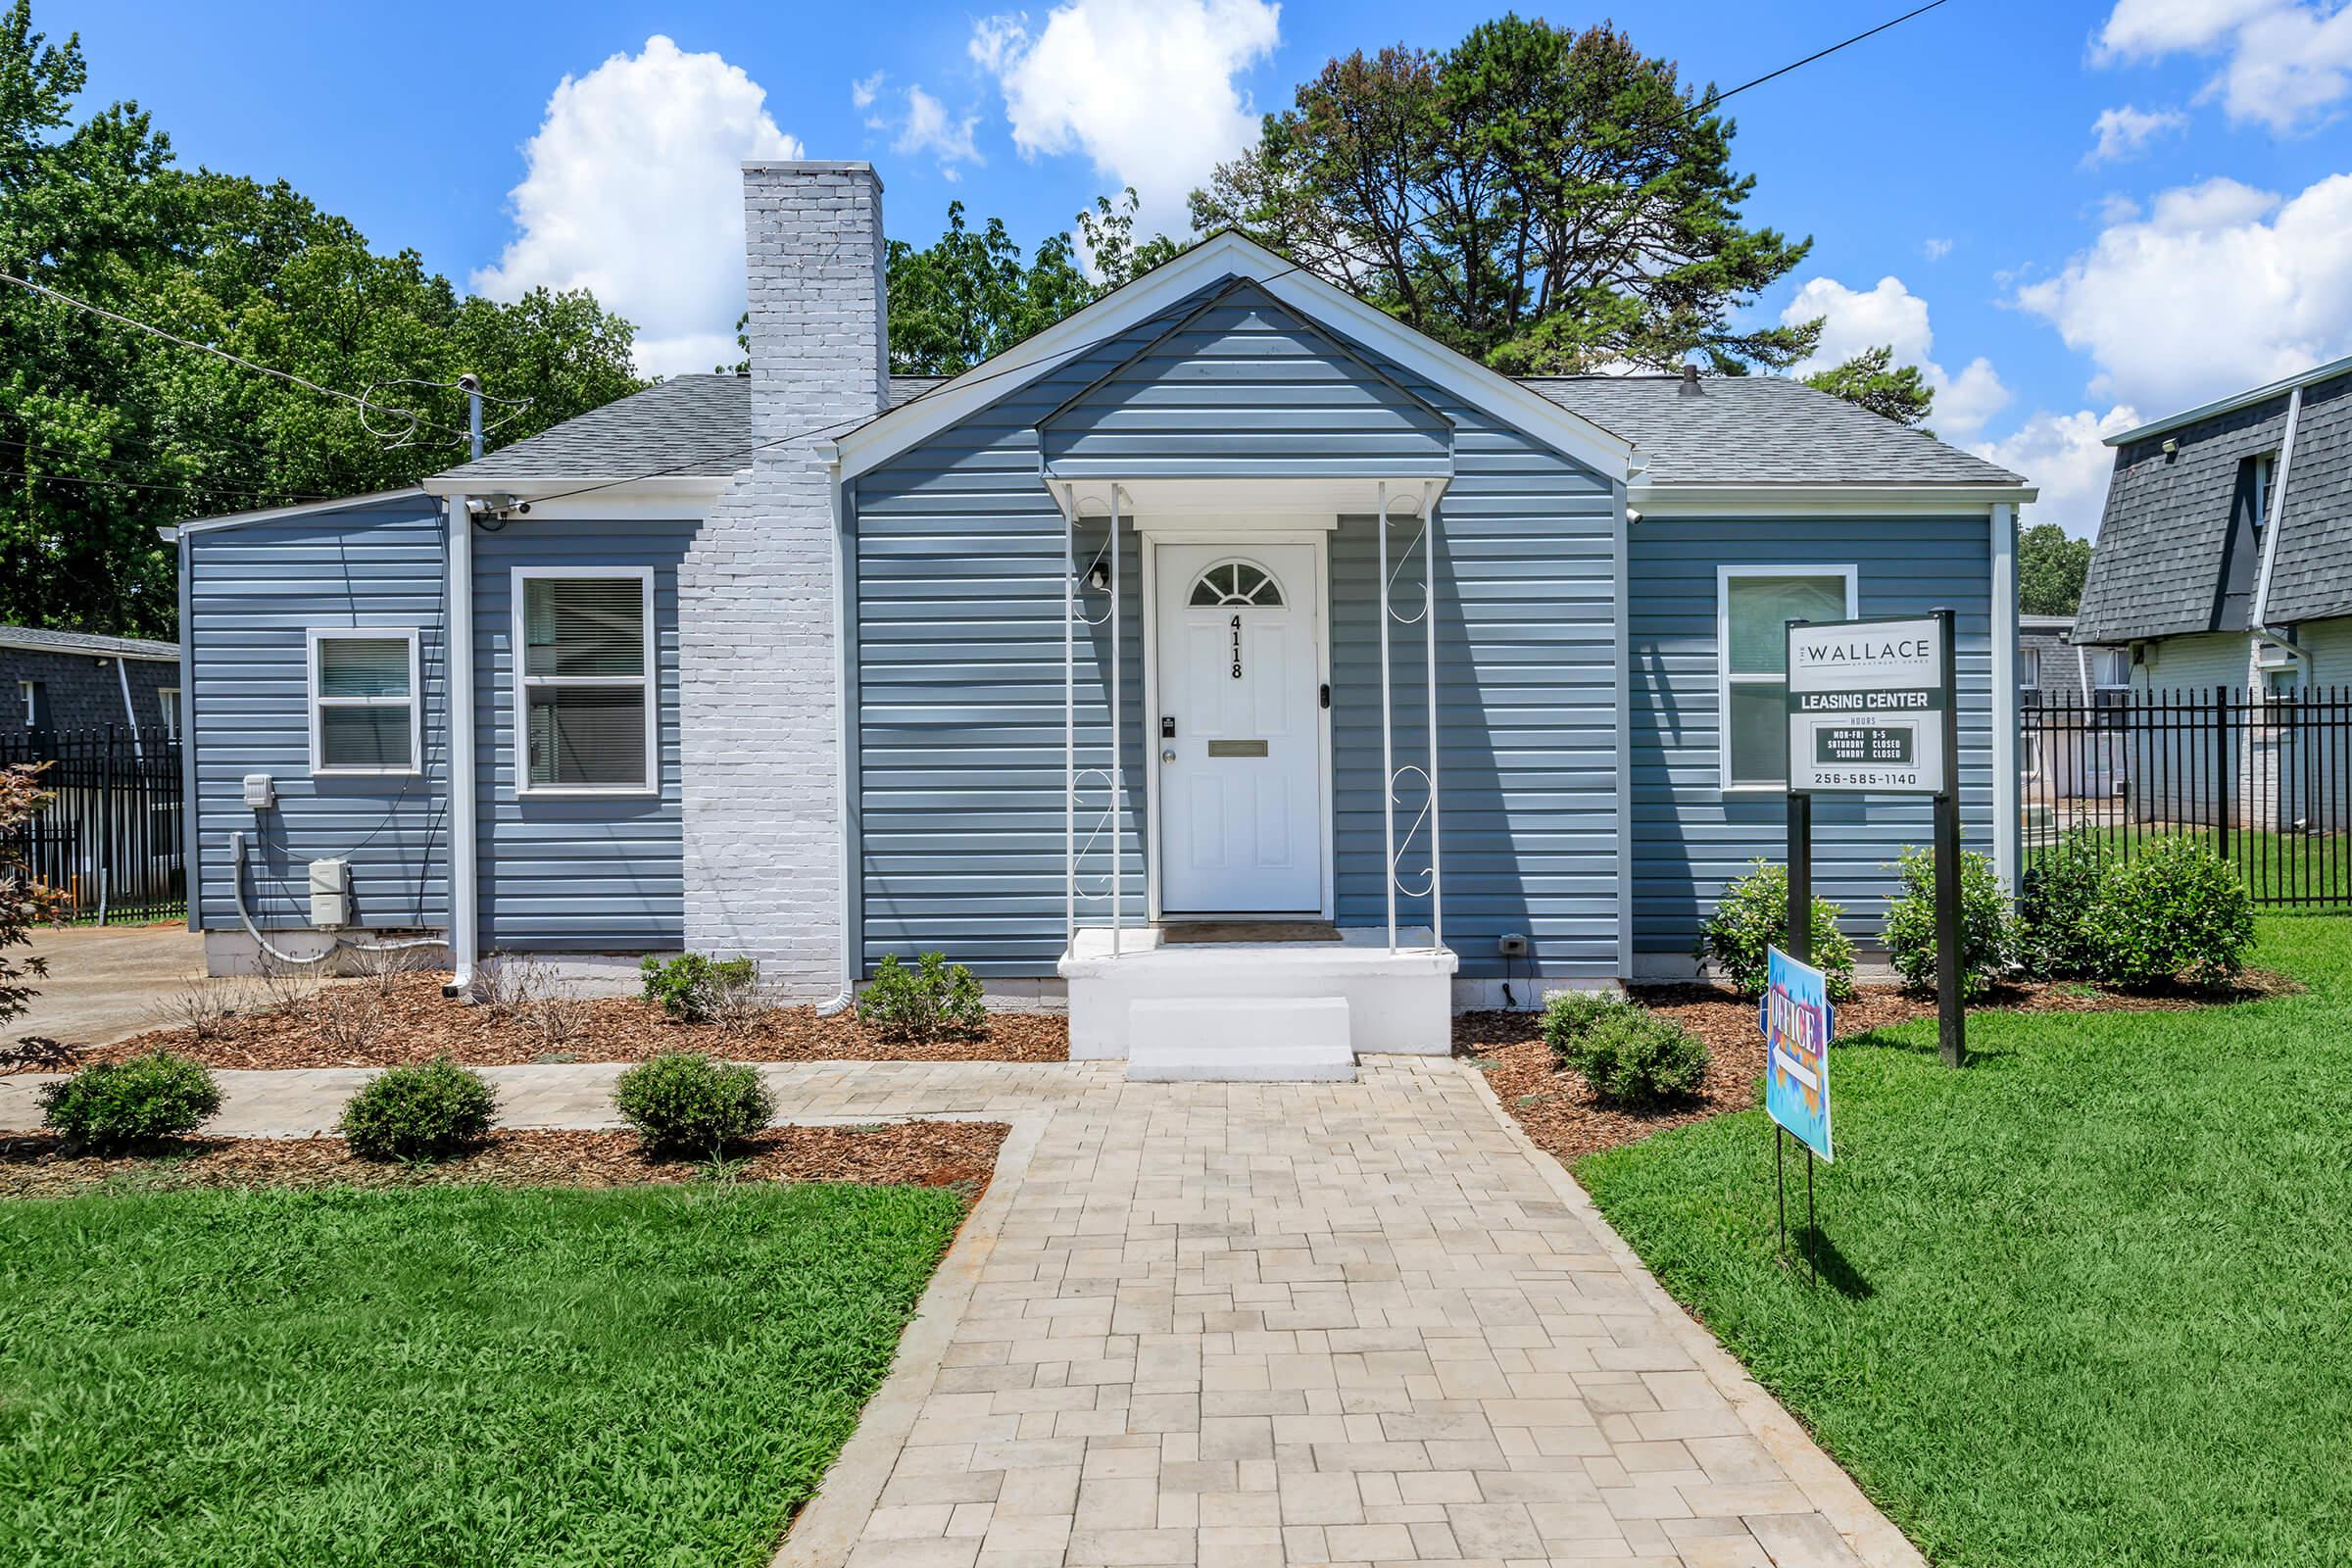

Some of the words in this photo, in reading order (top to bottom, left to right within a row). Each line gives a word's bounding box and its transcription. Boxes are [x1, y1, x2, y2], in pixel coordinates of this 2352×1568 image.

[1231, 615, 1242, 678] 4118
[1808, 640, 1929, 661] WALLACE
[1801, 694, 1863, 710] LEASING
[1867, 692, 1928, 709] CENTER
[1834, 730, 1864, 739] MON-FRI
[1828, 740, 1864, 749] SATURDAY
[1872, 740, 1900, 749] CLOSED
[1836, 750, 1864, 759] SUNDAY
[1873, 750, 1900, 759] CLOSED
[1815, 773, 1916, 785] 256-585-1140
[1771, 989, 1816, 1054] OFFICE
